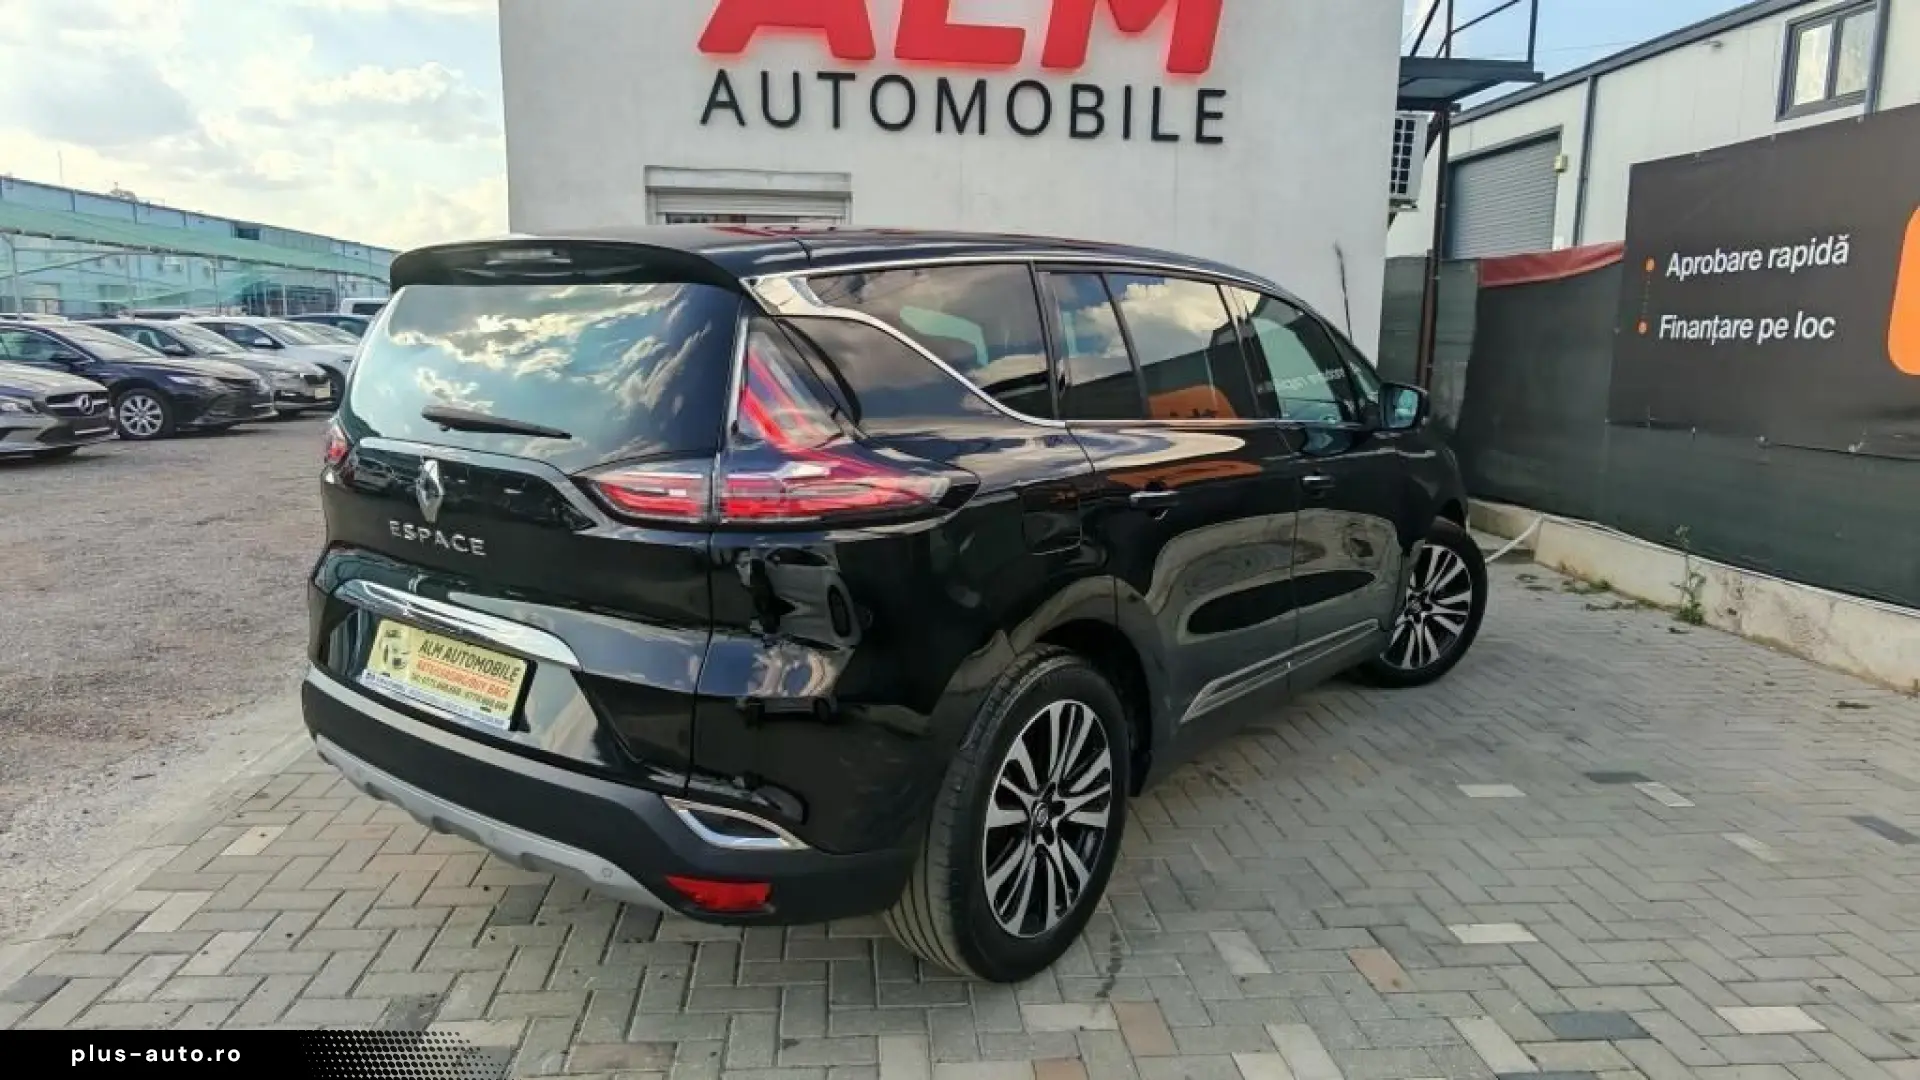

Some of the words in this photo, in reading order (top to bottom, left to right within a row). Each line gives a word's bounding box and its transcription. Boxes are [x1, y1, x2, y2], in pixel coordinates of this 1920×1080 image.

[700, 69, 1227, 144] AUTOMOBILE
[1665, 246, 1762, 281] Aprobare
[1768, 233, 1850, 274] rapidă
[1659, 313, 1754, 345] Finanțare
[1757, 316, 1789, 345] pe
[1794, 310, 1837, 339] loc
[389, 520, 487, 556] ESPACE
[418, 639, 445, 659] ALM
[442, 645, 521, 683] AUTOMOBILE
